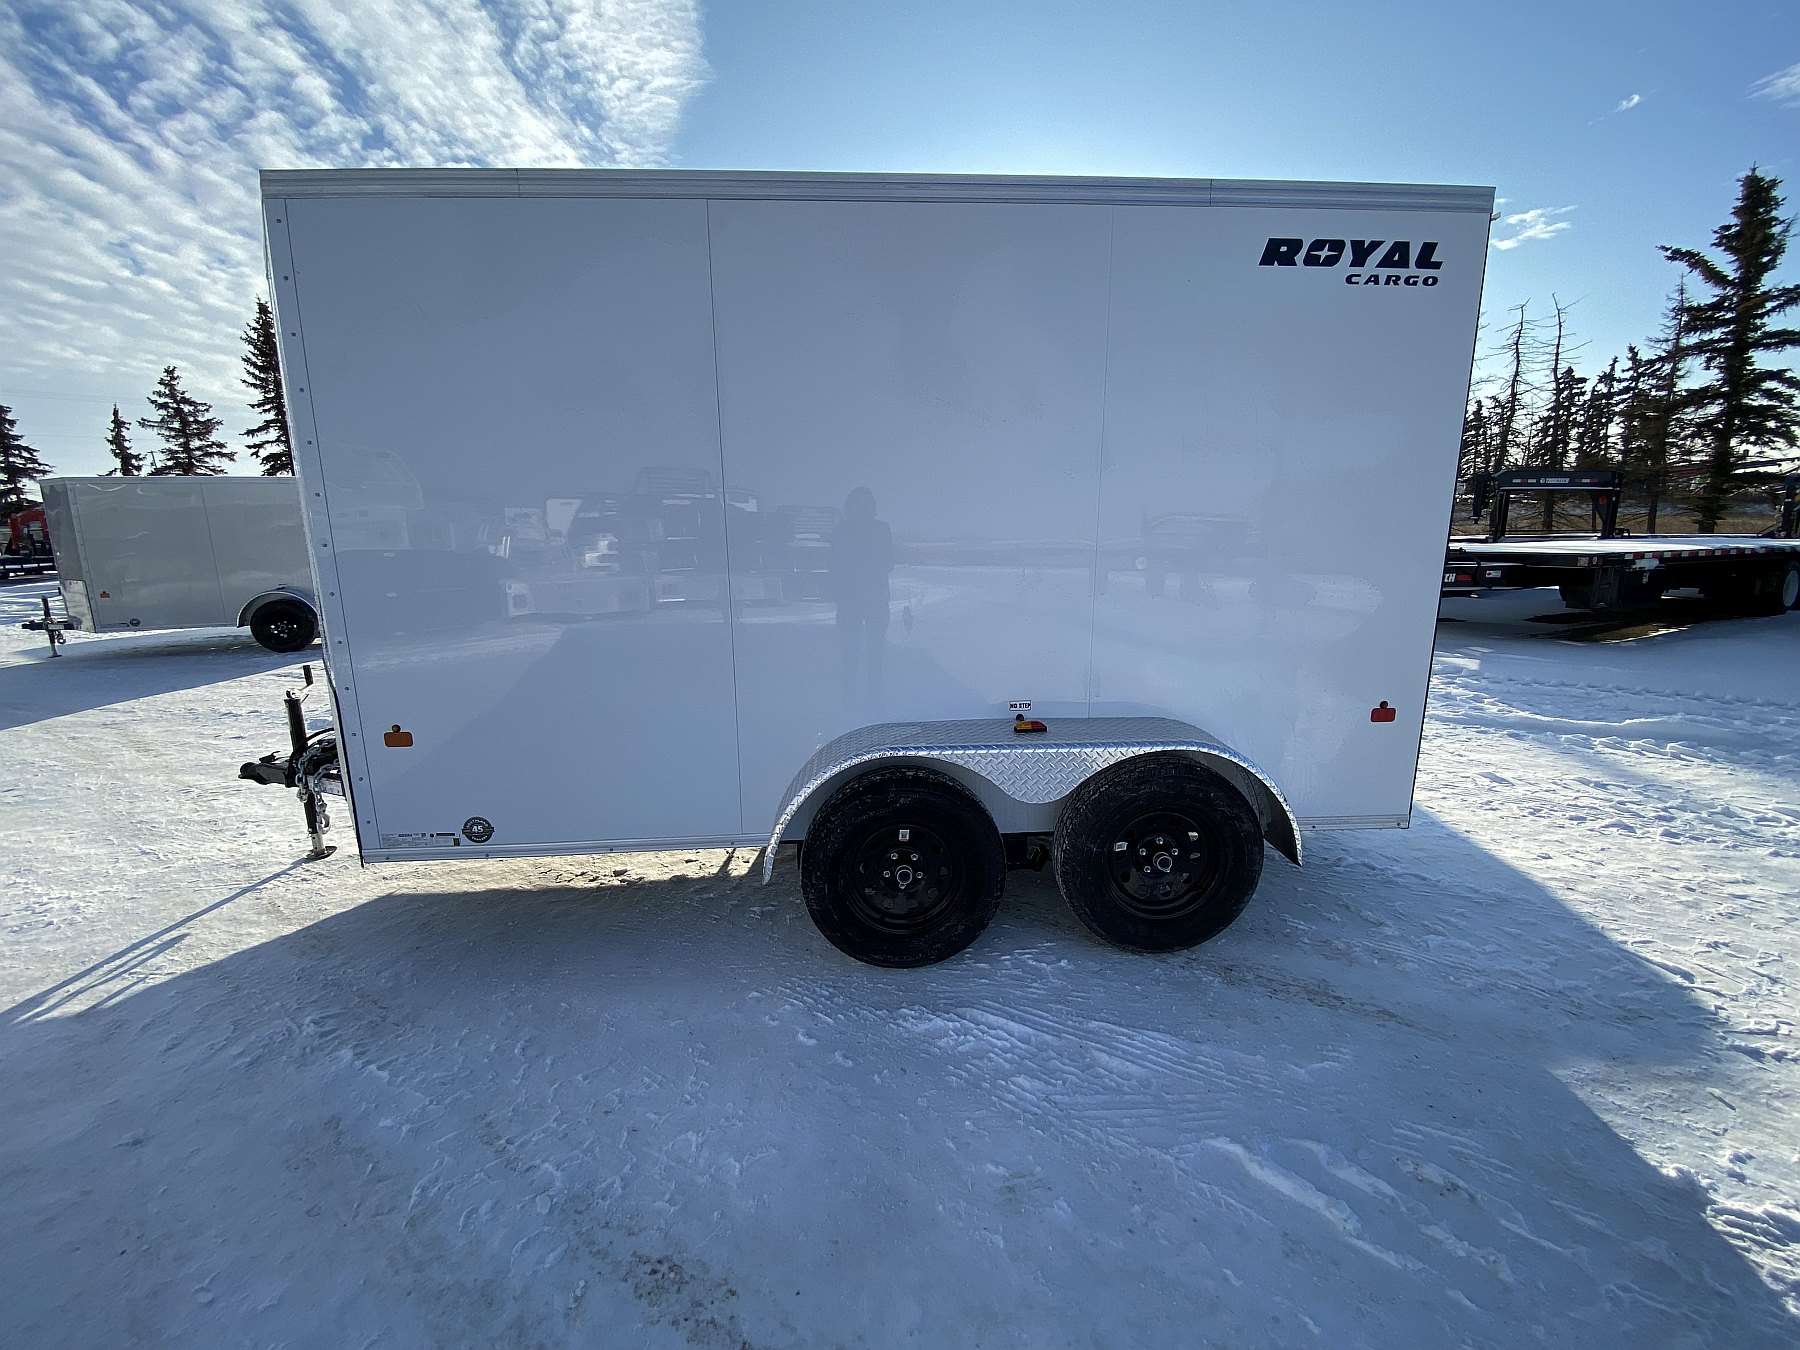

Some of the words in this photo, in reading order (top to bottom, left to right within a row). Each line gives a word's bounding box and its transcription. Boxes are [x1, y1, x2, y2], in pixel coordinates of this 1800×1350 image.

[1258, 237, 1443, 270] ROYAL
[1345, 273, 1439, 287] CARGO
[472, 825, 483, 833] 45
